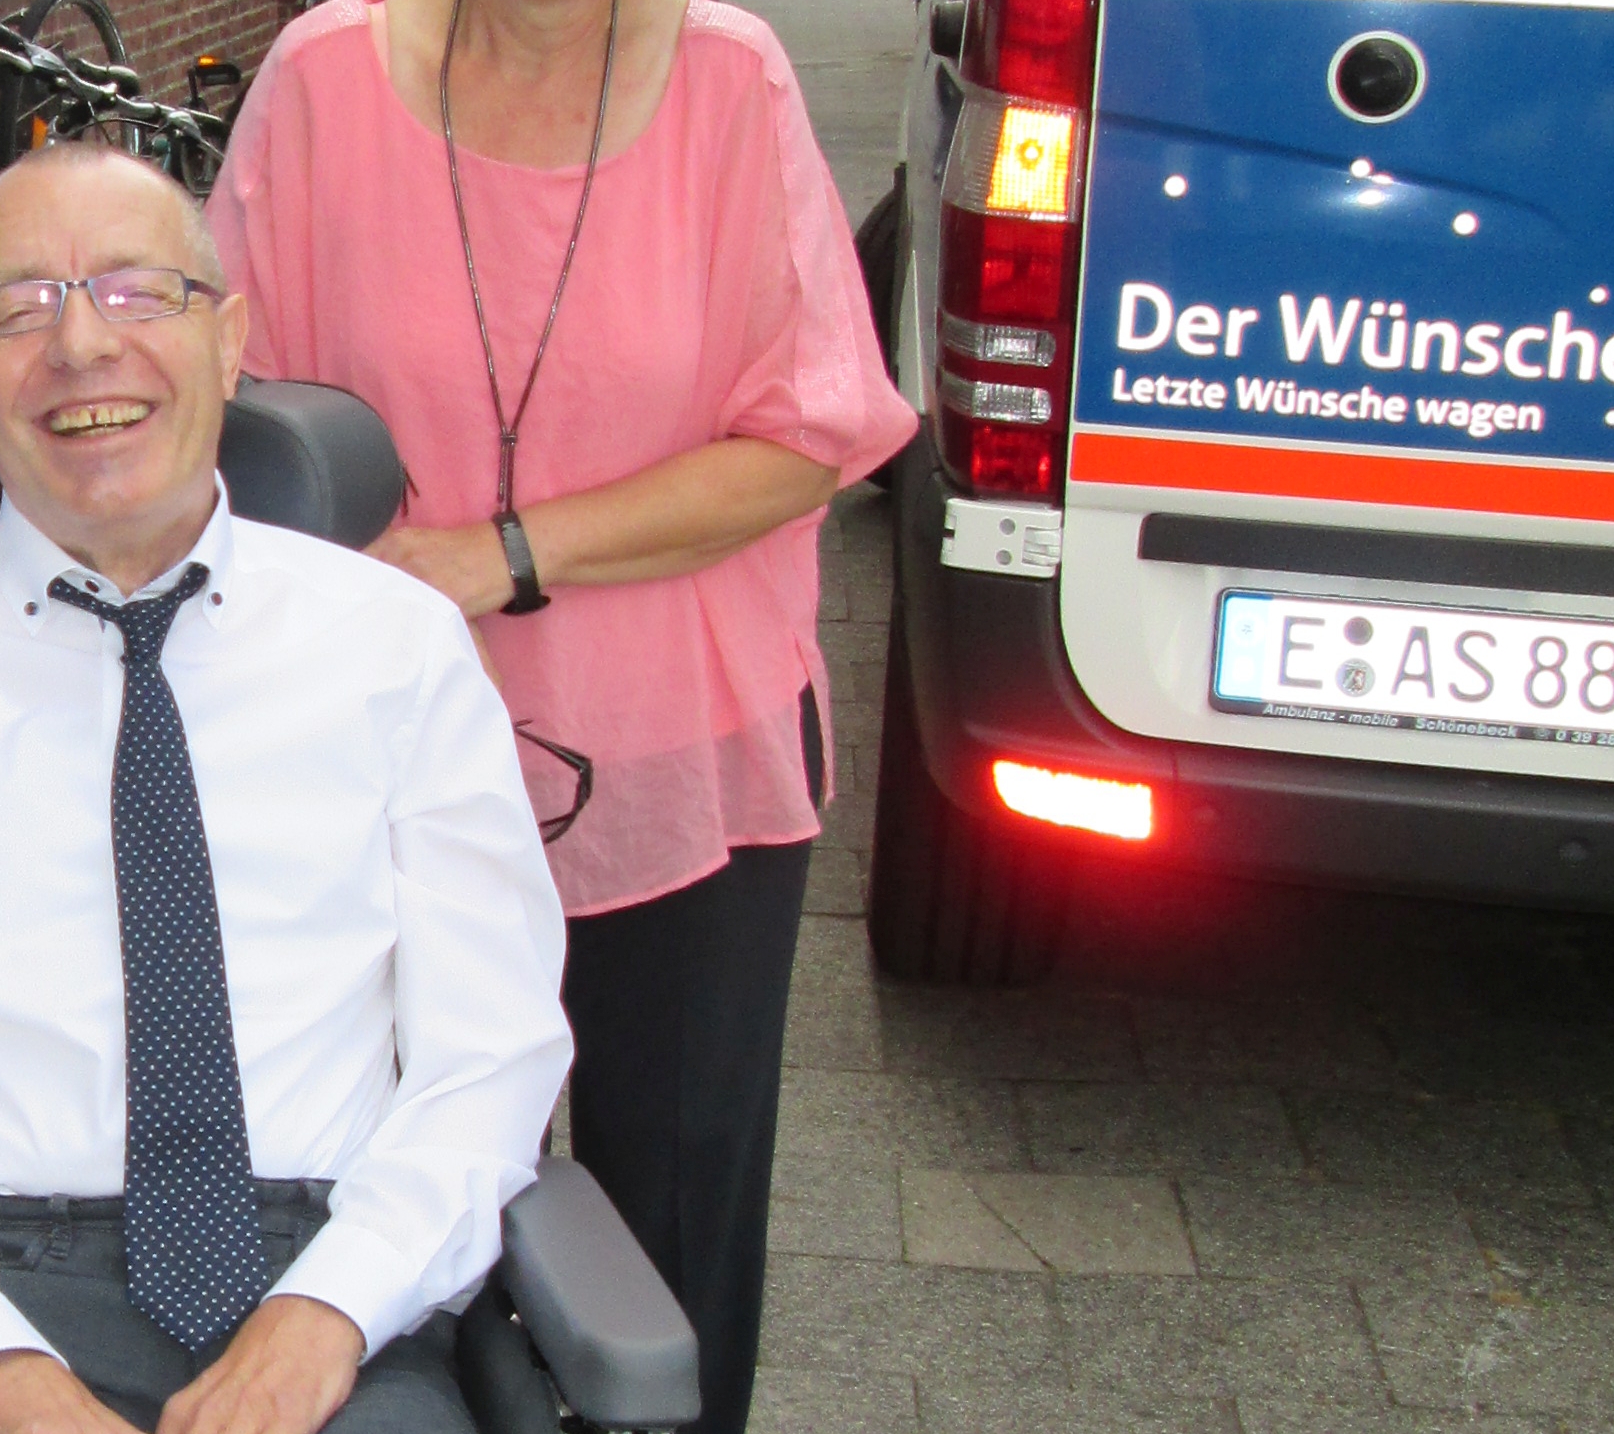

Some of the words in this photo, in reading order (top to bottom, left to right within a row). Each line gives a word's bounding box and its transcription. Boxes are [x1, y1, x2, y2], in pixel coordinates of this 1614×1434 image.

[1117, 281, 1260, 359] Der
[1111, 366, 1228, 410] Letzte
[1235, 375, 1407, 424] Wünsche
[1416, 397, 1544, 438] wagen
[1277, 615, 1326, 689] E
[1390, 625, 1498, 704] AS
[1262, 703, 1335, 722] Ambulanz
[1348, 712, 1400, 728] mobile
[1415, 716, 1519, 739] Schönebeck
